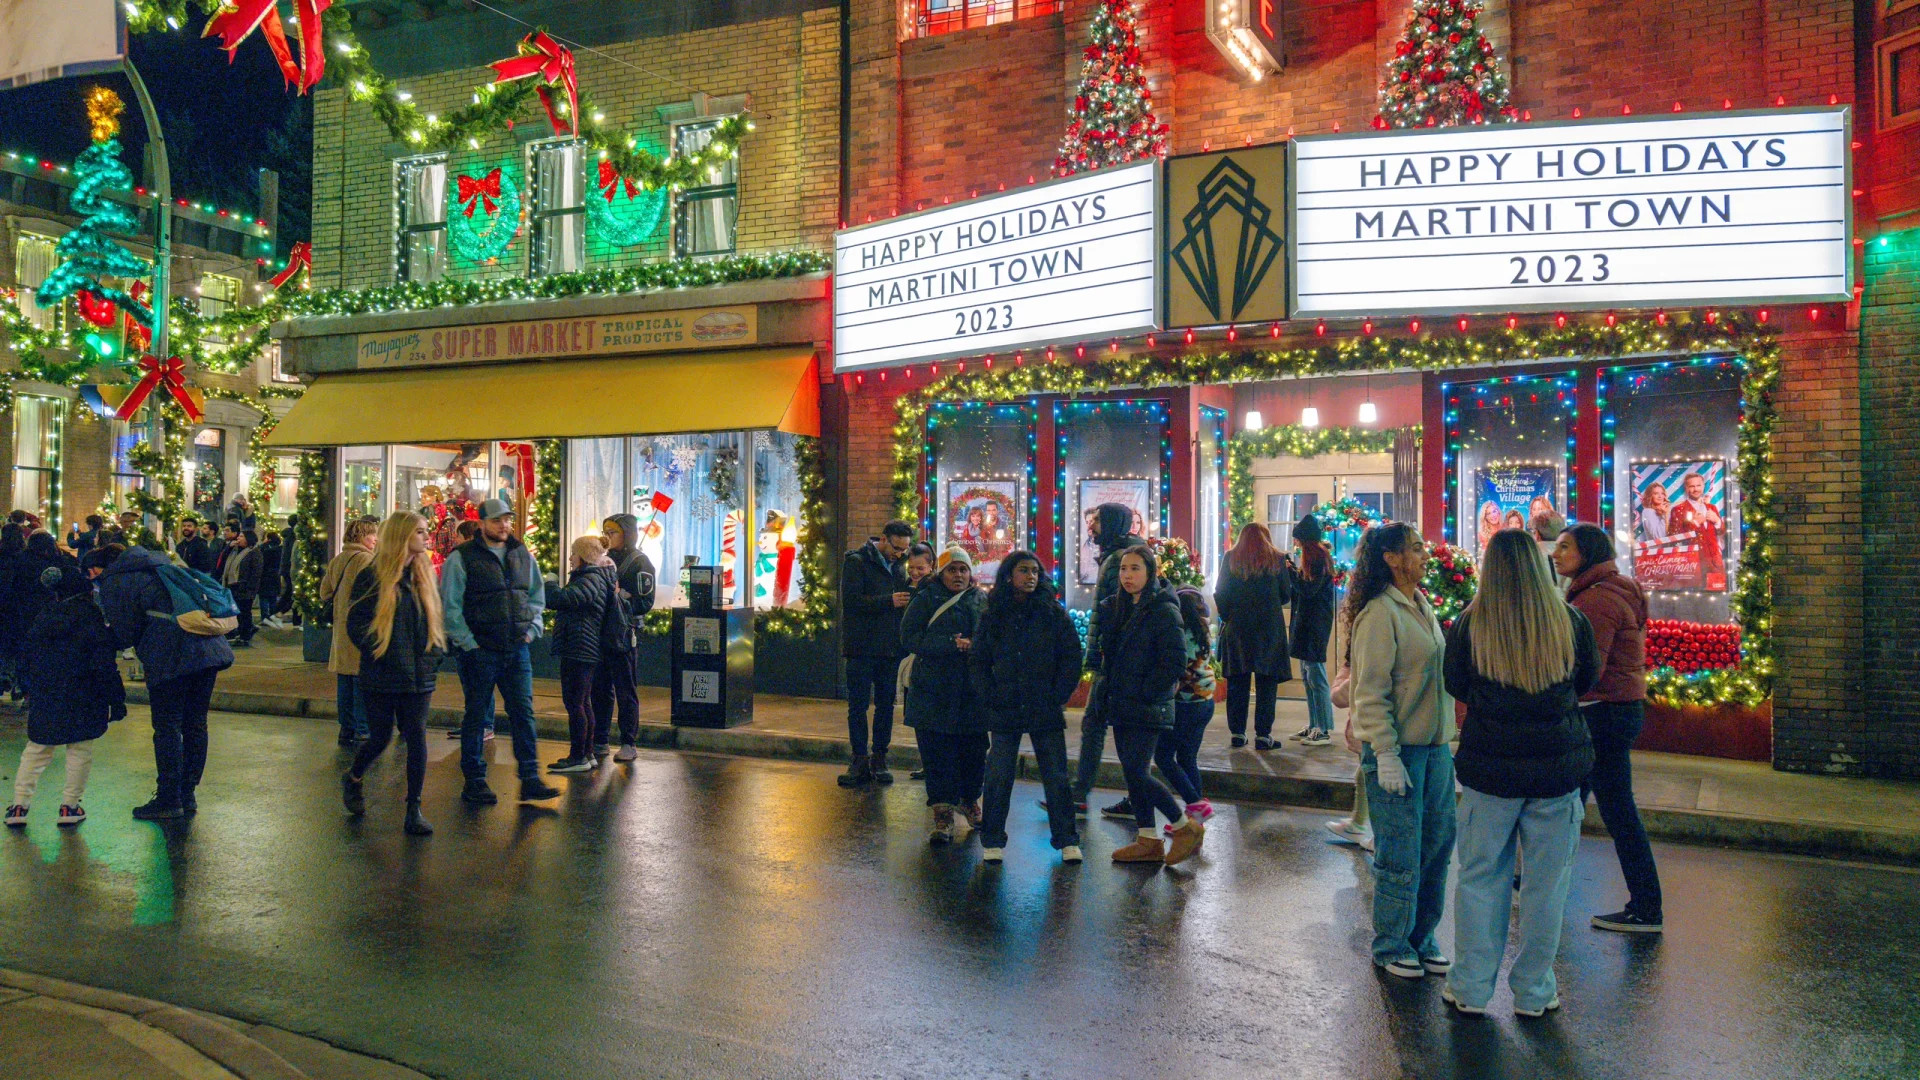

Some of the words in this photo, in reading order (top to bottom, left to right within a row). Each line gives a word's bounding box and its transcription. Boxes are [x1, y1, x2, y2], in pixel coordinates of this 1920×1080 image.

[1360, 152, 1513, 188] HAPPY
[1537, 138, 1787, 179] HOLIDAYS
[1355, 203, 1552, 240] MARTINI
[1575, 194, 1731, 230] TOWN
[861, 230, 943, 269] HAPPY
[957, 195, 1107, 250] HOLIDAYS
[868, 266, 976, 307] MARTINI
[989, 246, 1083, 286] TOWN
[1509, 254, 1611, 285] 2023
[602, 317, 684, 333] TROPICAL
[955, 305, 1013, 336] 2023
[431, 327, 497, 361] SUPER
[507, 320, 597, 355] MARKET
[602, 331, 684, 346] PRODUCTS
[360, 332, 421, 364] Mayaguez
[409, 351, 426, 361] 234
[1495, 485, 1535, 493] Christmas
[1499, 492, 1531, 504] Village
[1644, 562, 1698, 577] CHRISTMAS!
[691, 682, 709, 690] YORK
[693, 675, 708, 683] NEW
[691, 689, 708, 699] POST
